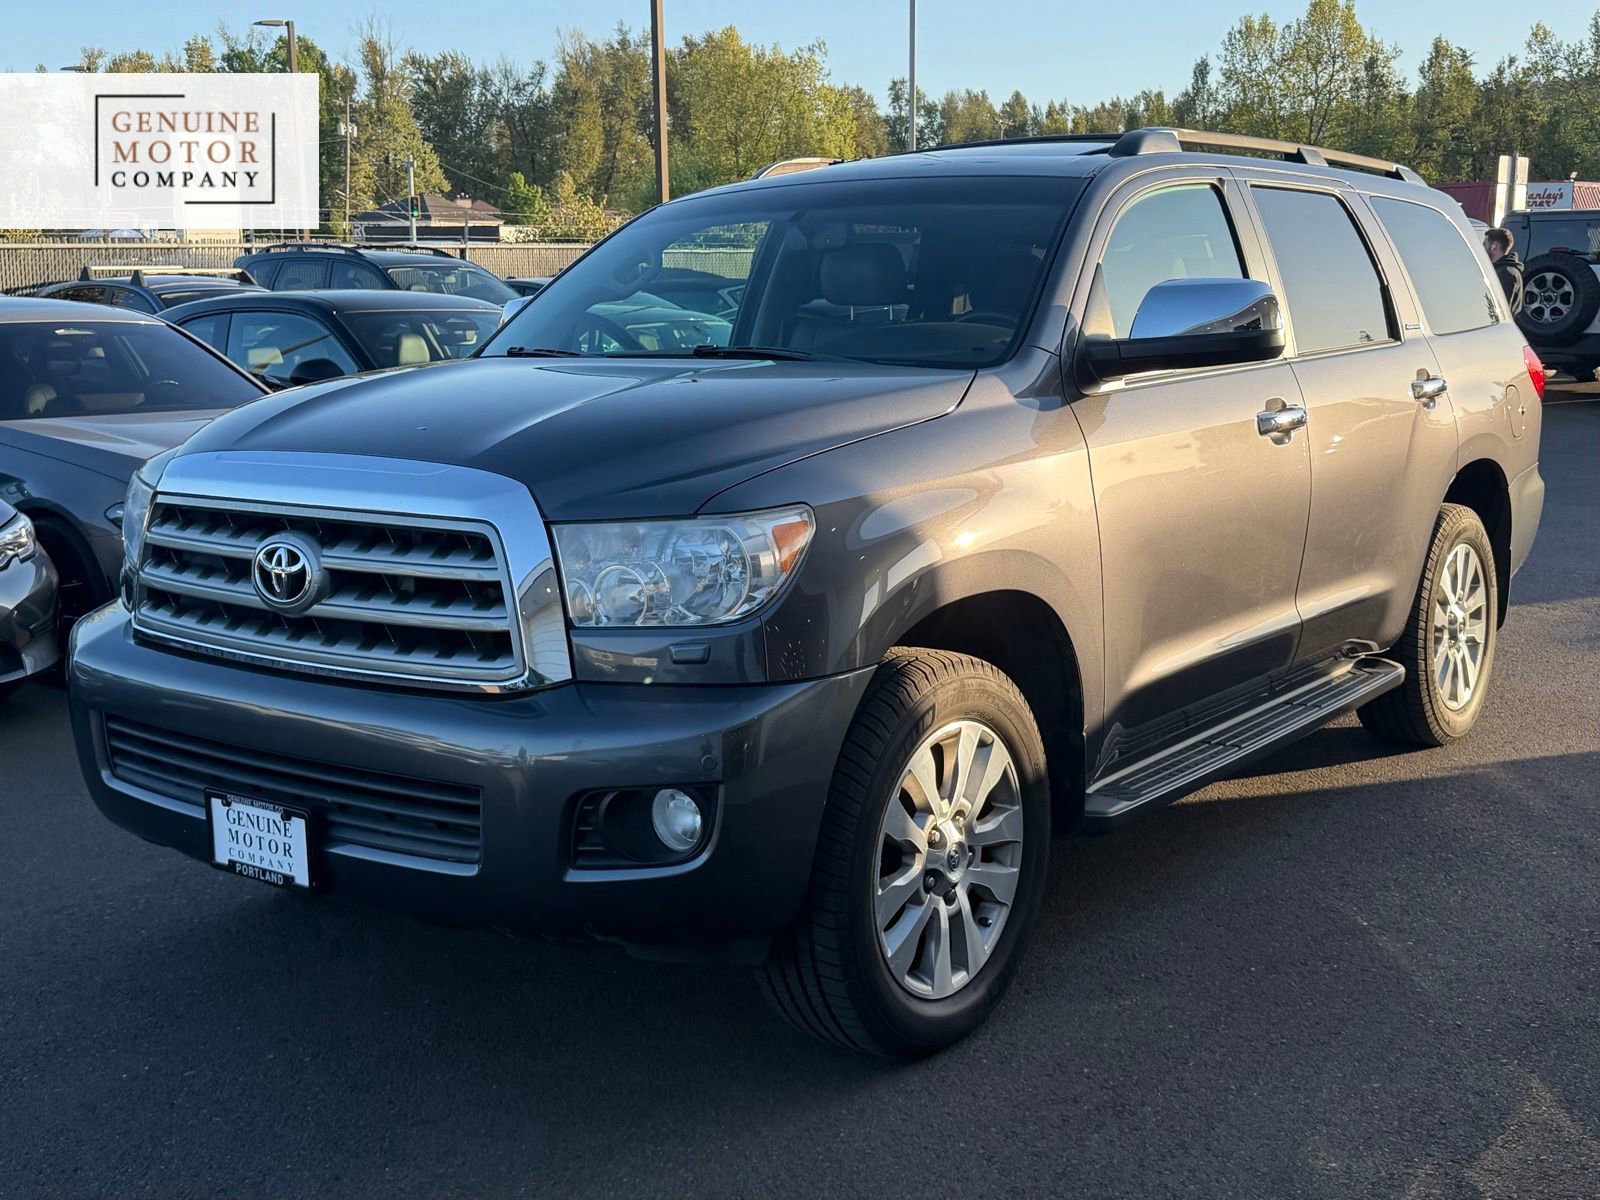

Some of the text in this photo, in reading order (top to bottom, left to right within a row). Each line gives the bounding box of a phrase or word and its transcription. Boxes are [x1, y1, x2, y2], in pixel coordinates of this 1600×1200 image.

[226, 807, 293, 839] GENUINE
[228, 827, 294, 859] MOTOR
[228, 846, 295, 873] COMPANY
[236, 863, 284, 885] PORTLAND
